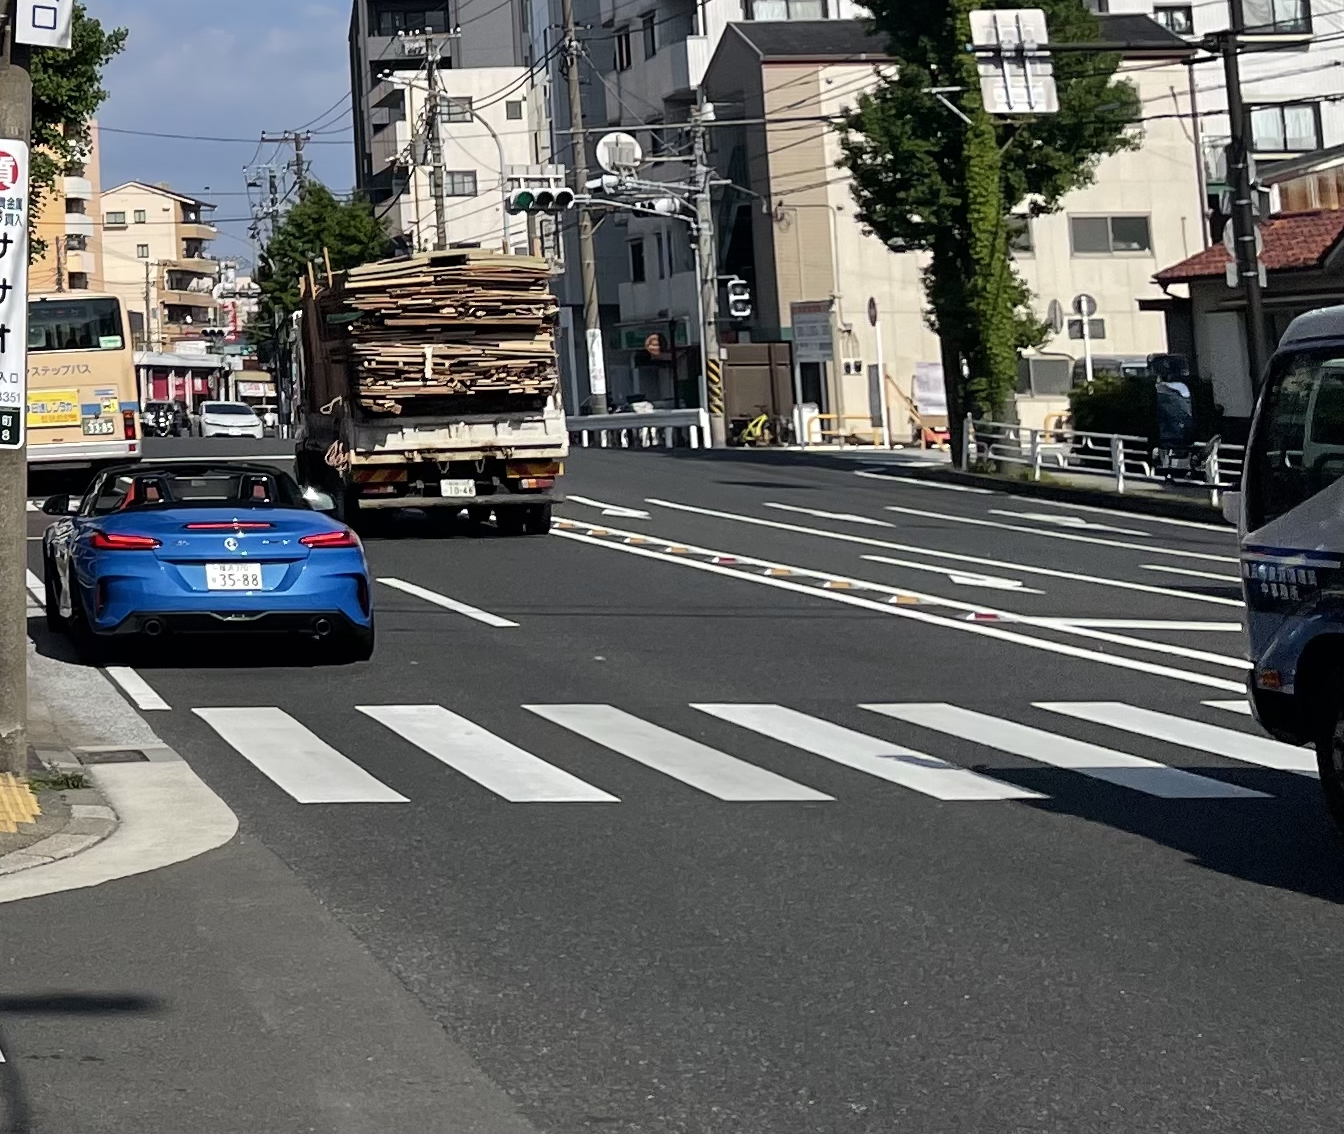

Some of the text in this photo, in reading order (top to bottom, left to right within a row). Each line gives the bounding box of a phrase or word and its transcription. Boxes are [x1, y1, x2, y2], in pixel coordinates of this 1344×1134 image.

[26, 364, 92, 378] ステップバス
[218, 573, 259, 587] 35-88
